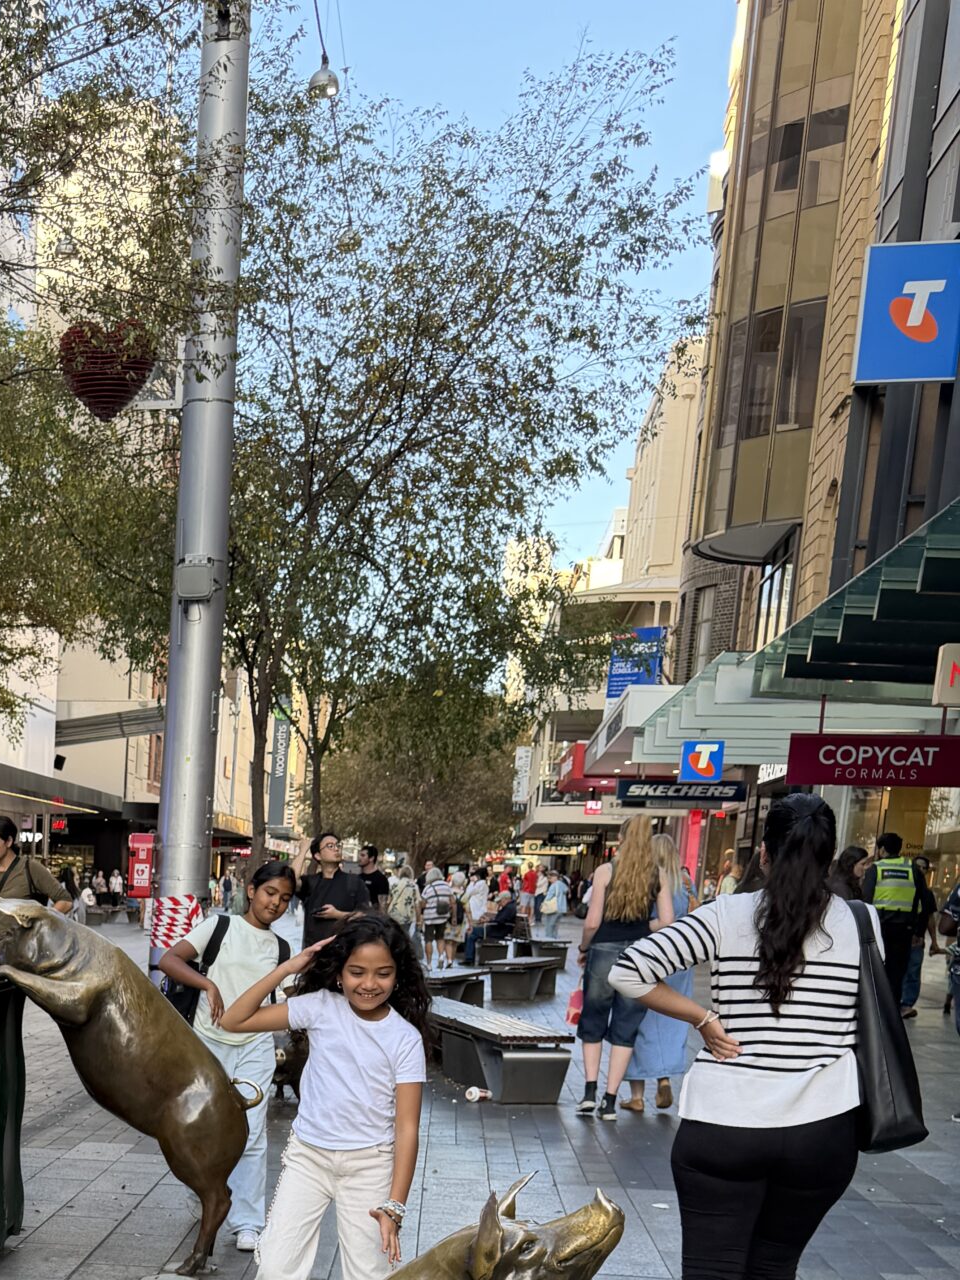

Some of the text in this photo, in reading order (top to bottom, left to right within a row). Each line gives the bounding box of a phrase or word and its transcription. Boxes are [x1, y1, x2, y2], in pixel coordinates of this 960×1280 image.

[903, 280, 947, 327] T
[695, 744, 719, 768] T
[819, 745, 939, 766] COPYCAT
[835, 768, 917, 780] FORMALS
[627, 784, 738, 797] SKECHERS
